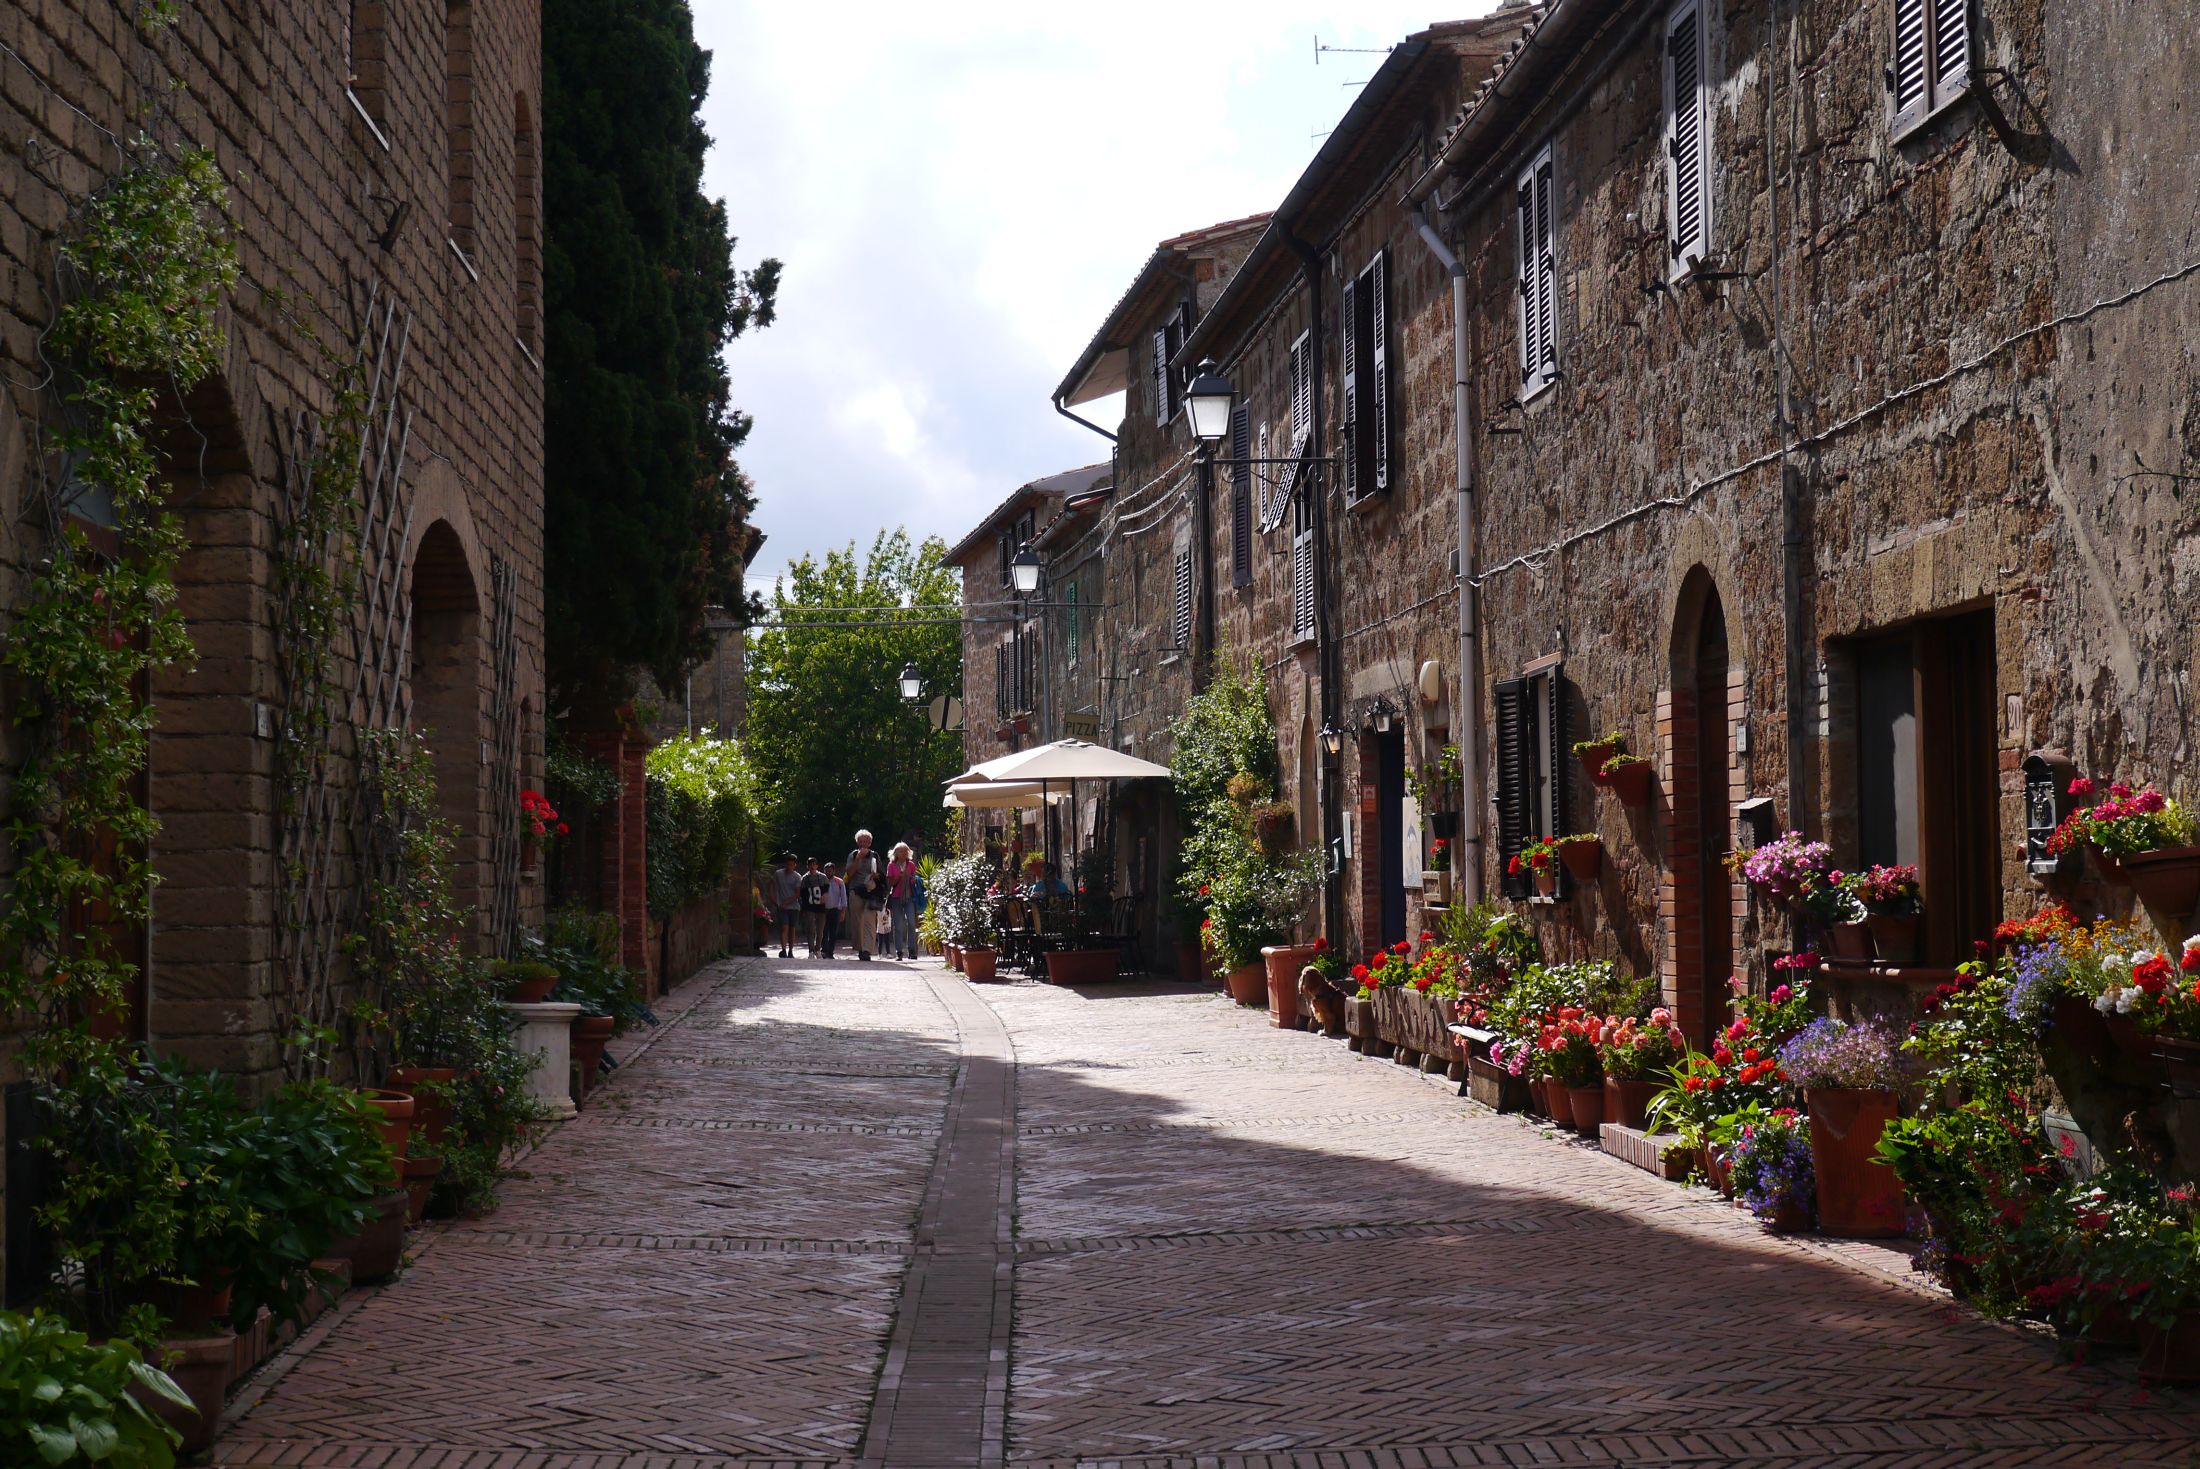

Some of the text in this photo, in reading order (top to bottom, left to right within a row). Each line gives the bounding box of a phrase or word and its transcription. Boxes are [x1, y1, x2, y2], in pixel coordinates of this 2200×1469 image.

[2008, 702, 2021, 731] 20
[1065, 721, 1098, 737] PIZZA
[808, 886, 822, 905] 19
